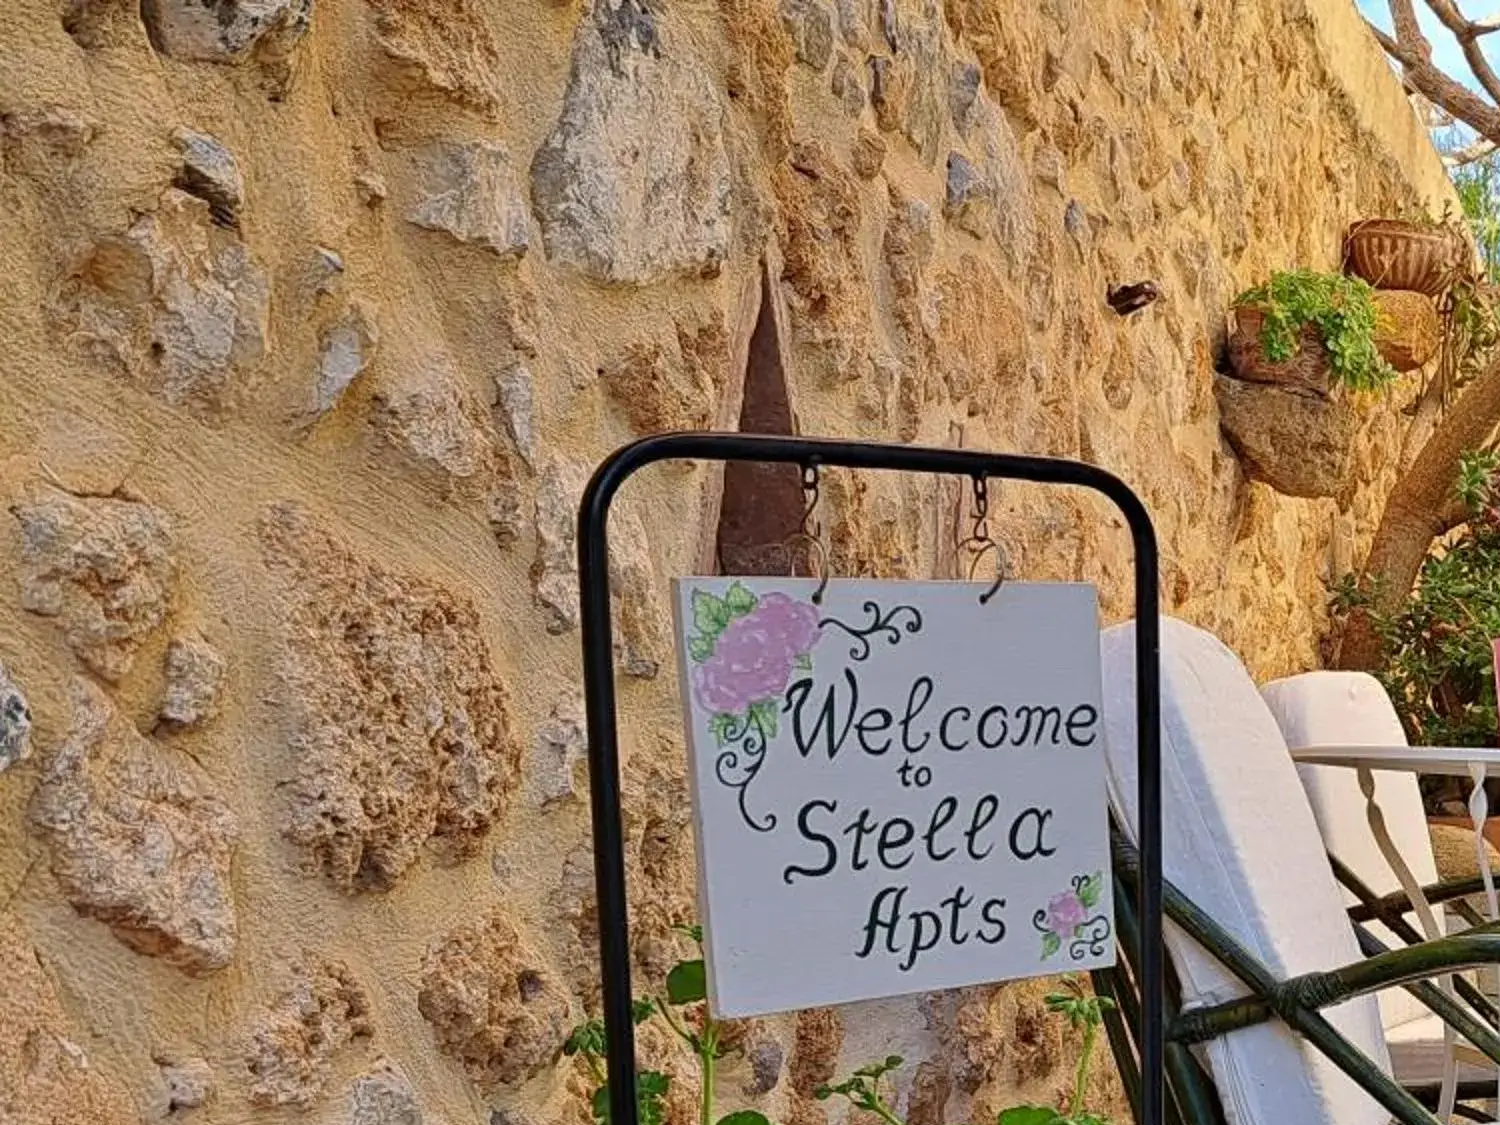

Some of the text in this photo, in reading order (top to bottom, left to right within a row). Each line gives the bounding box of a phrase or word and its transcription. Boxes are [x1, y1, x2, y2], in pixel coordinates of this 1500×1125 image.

[783, 667, 1099, 760] Welcome
[896, 758, 932, 788] to
[783, 794, 1057, 884] Stella
[854, 885, 1007, 971] Apts
